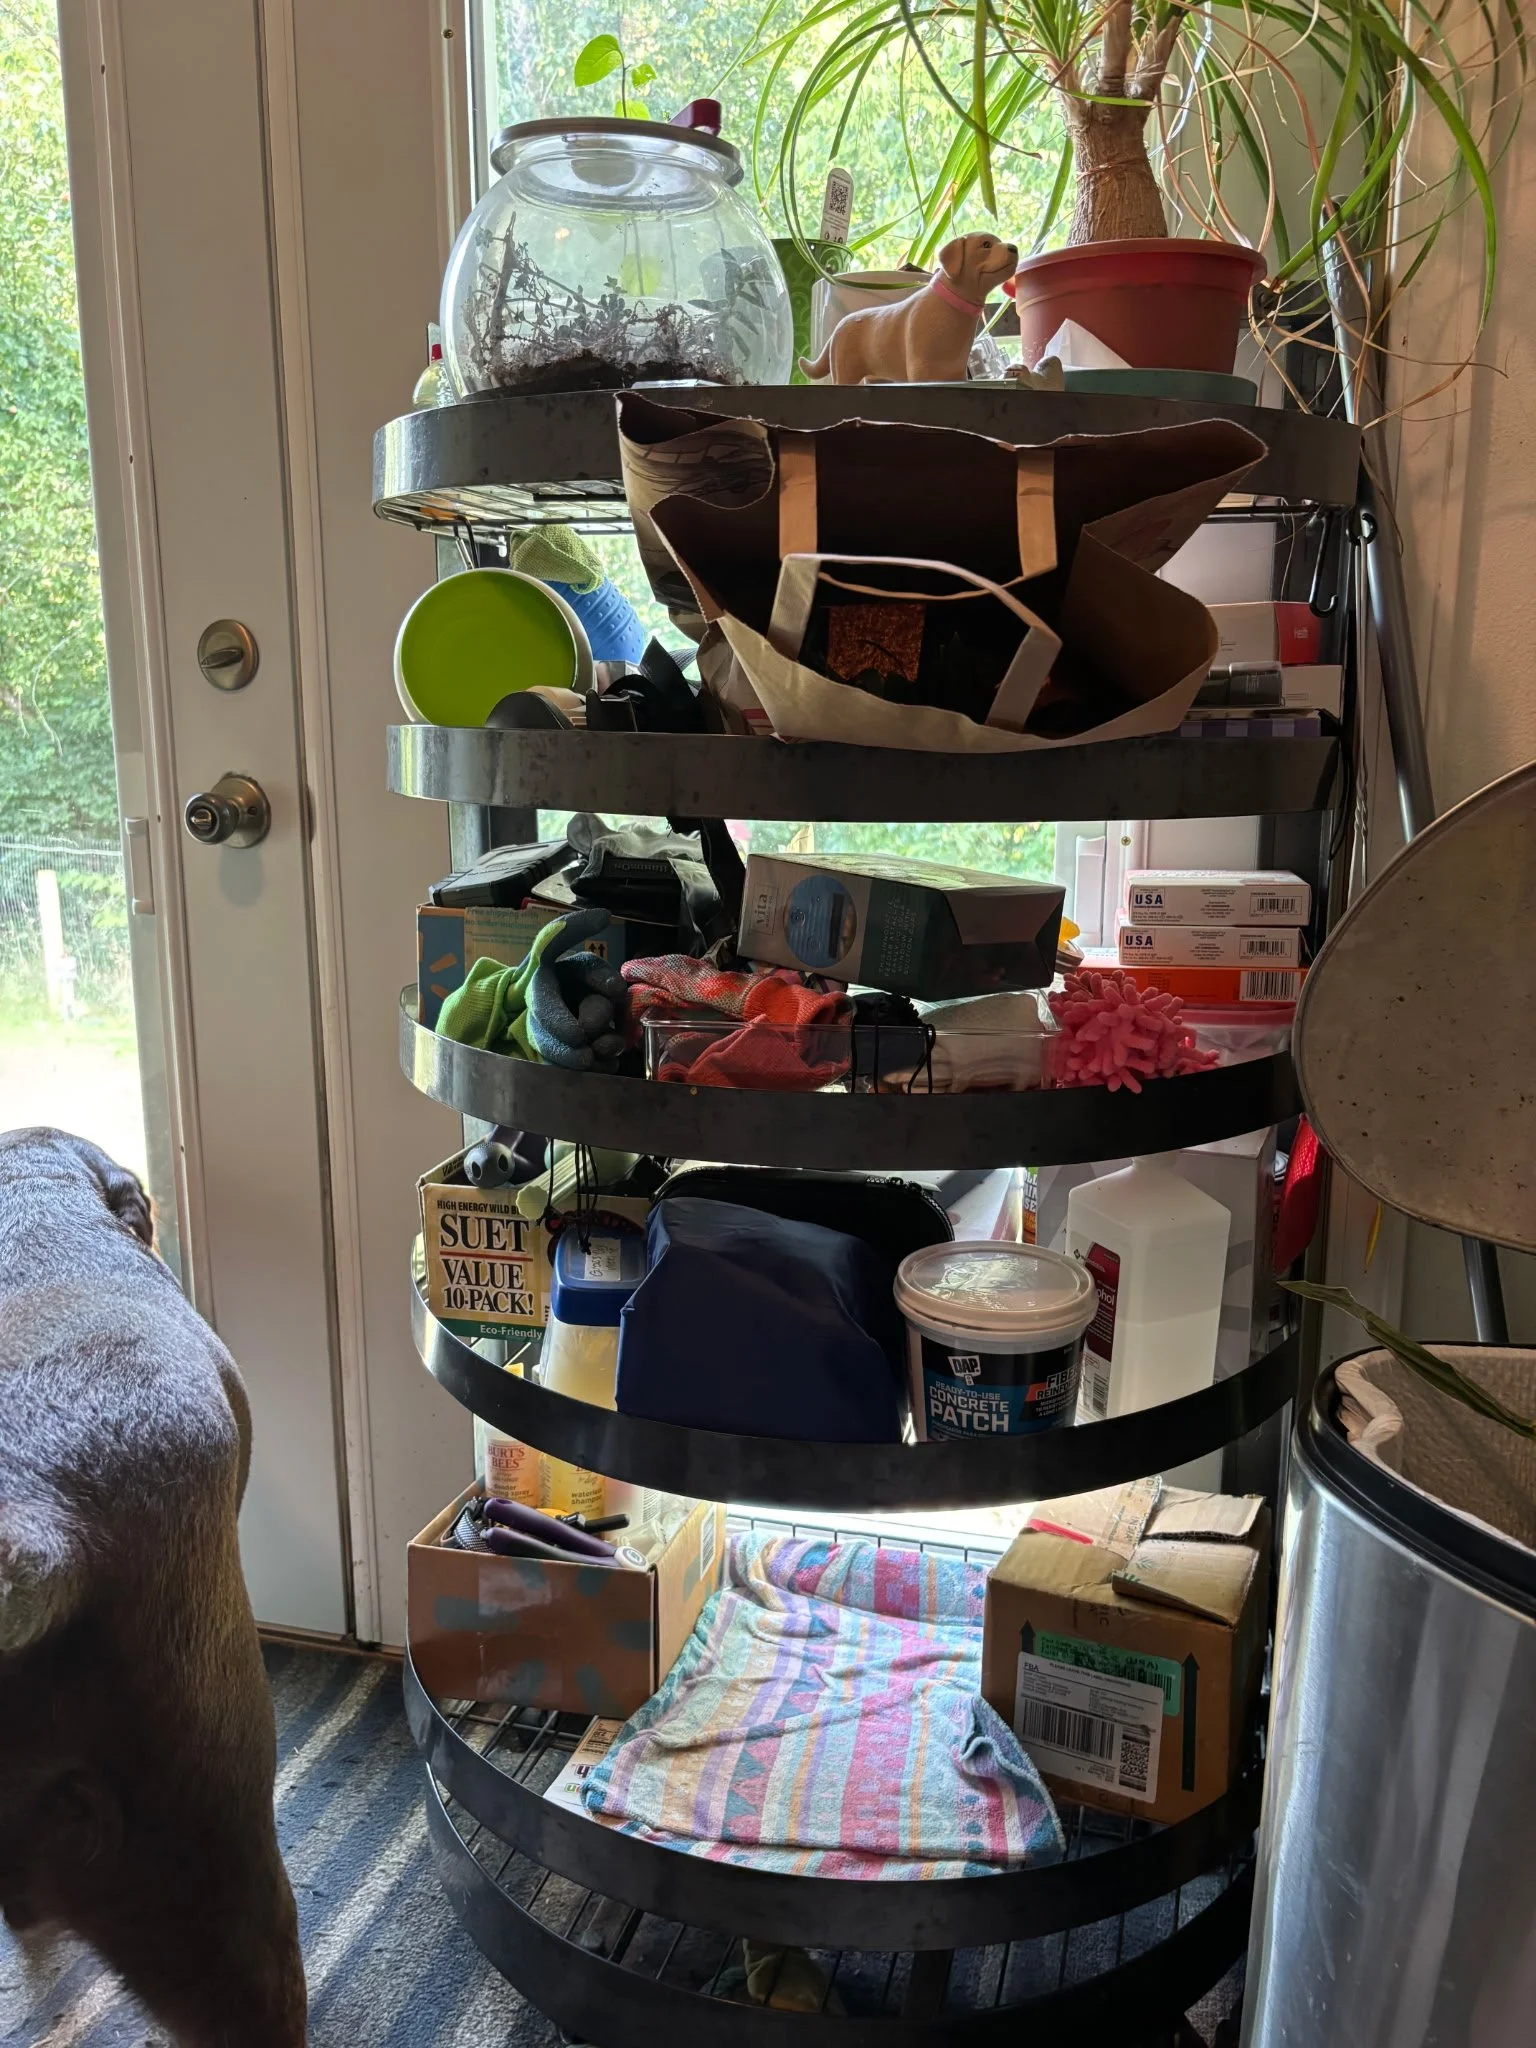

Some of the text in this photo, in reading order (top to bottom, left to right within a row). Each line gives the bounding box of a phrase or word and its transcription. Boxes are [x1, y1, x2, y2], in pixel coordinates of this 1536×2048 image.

[1134, 894, 1163, 905] USA
[753, 894, 767, 925] vita
[1125, 935, 1153, 946] USA
[437, 1201, 457, 1210] HIGH
[458, 1202, 488, 1213] ENERGY
[489, 1204, 510, 1213] WILD
[440, 1214, 530, 1253] SUET
[441, 1258, 525, 1290] VALUE
[443, 1286, 535, 1316] 10-PACK!
[480, 1324, 543, 1341] Eco-Friendly
[929, 1385, 1009, 1413] CONCRETE
[935, 1380, 1001, 1400] READY-TO-USE
[929, 1398, 1010, 1433] PATCH
[487, 1445, 525, 1459] BURT'S
[492, 1457, 520, 1469] BEES
[1023, 1661, 1039, 1672] FBA
